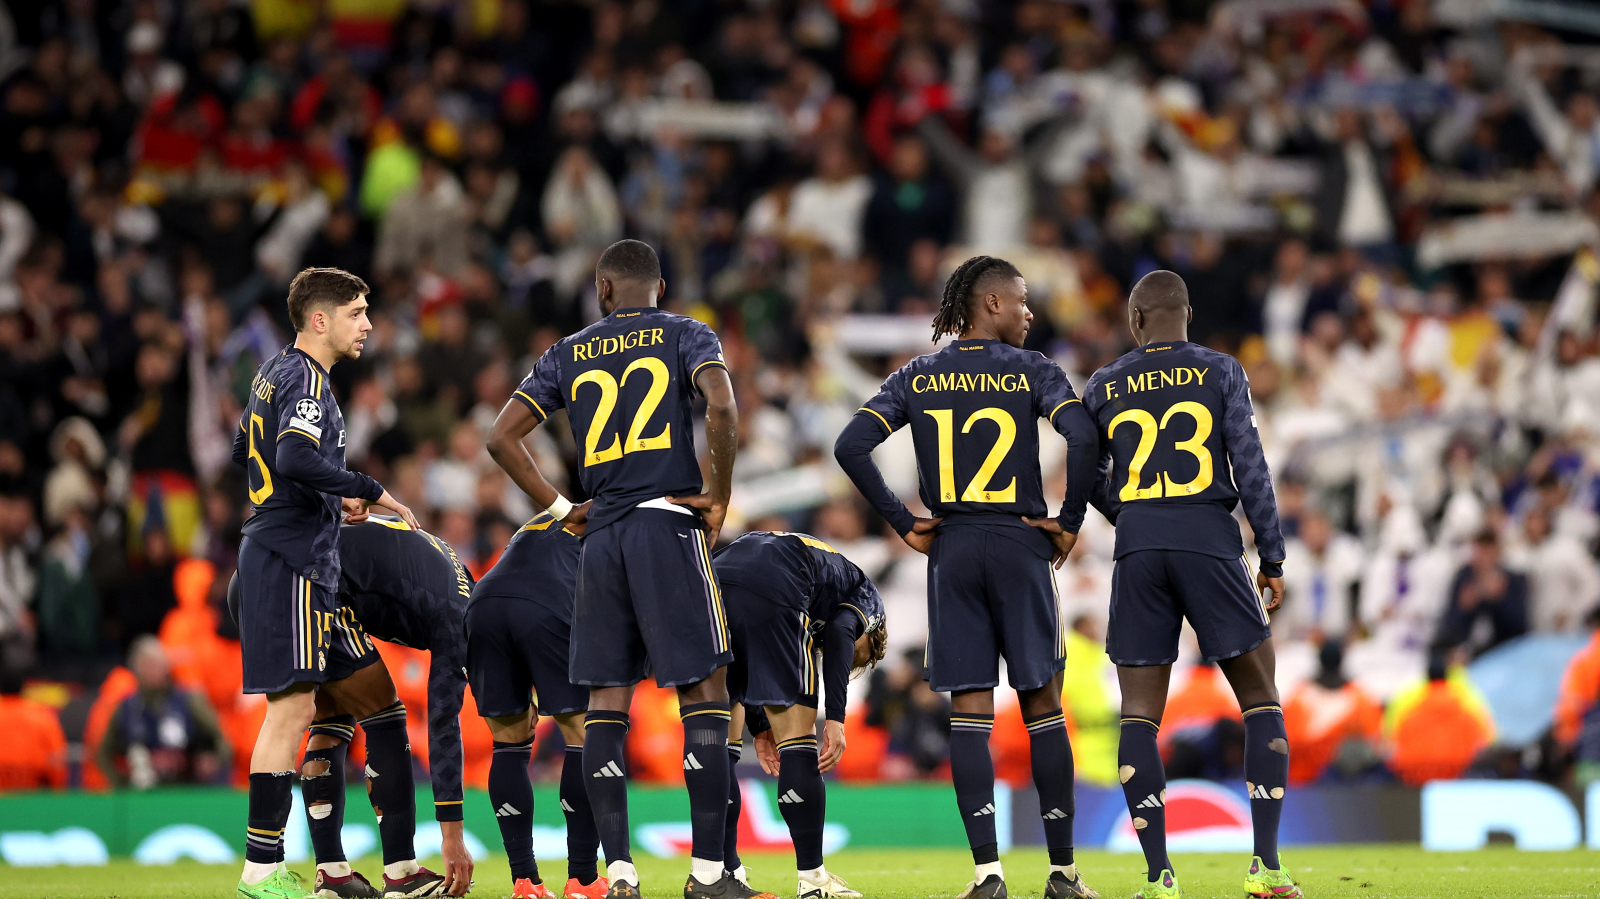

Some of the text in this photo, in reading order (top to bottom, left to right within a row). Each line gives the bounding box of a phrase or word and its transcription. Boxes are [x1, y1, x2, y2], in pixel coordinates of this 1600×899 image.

[572, 328, 665, 362] RÜDIGER
[911, 372, 1031, 394] CAMAVINGA
[1104, 367, 1209, 401] F. MENDY
[248, 410, 274, 505] 5
[571, 356, 671, 468] 22
[923, 407, 1017, 503] 12
[1107, 400, 1214, 503] 23
